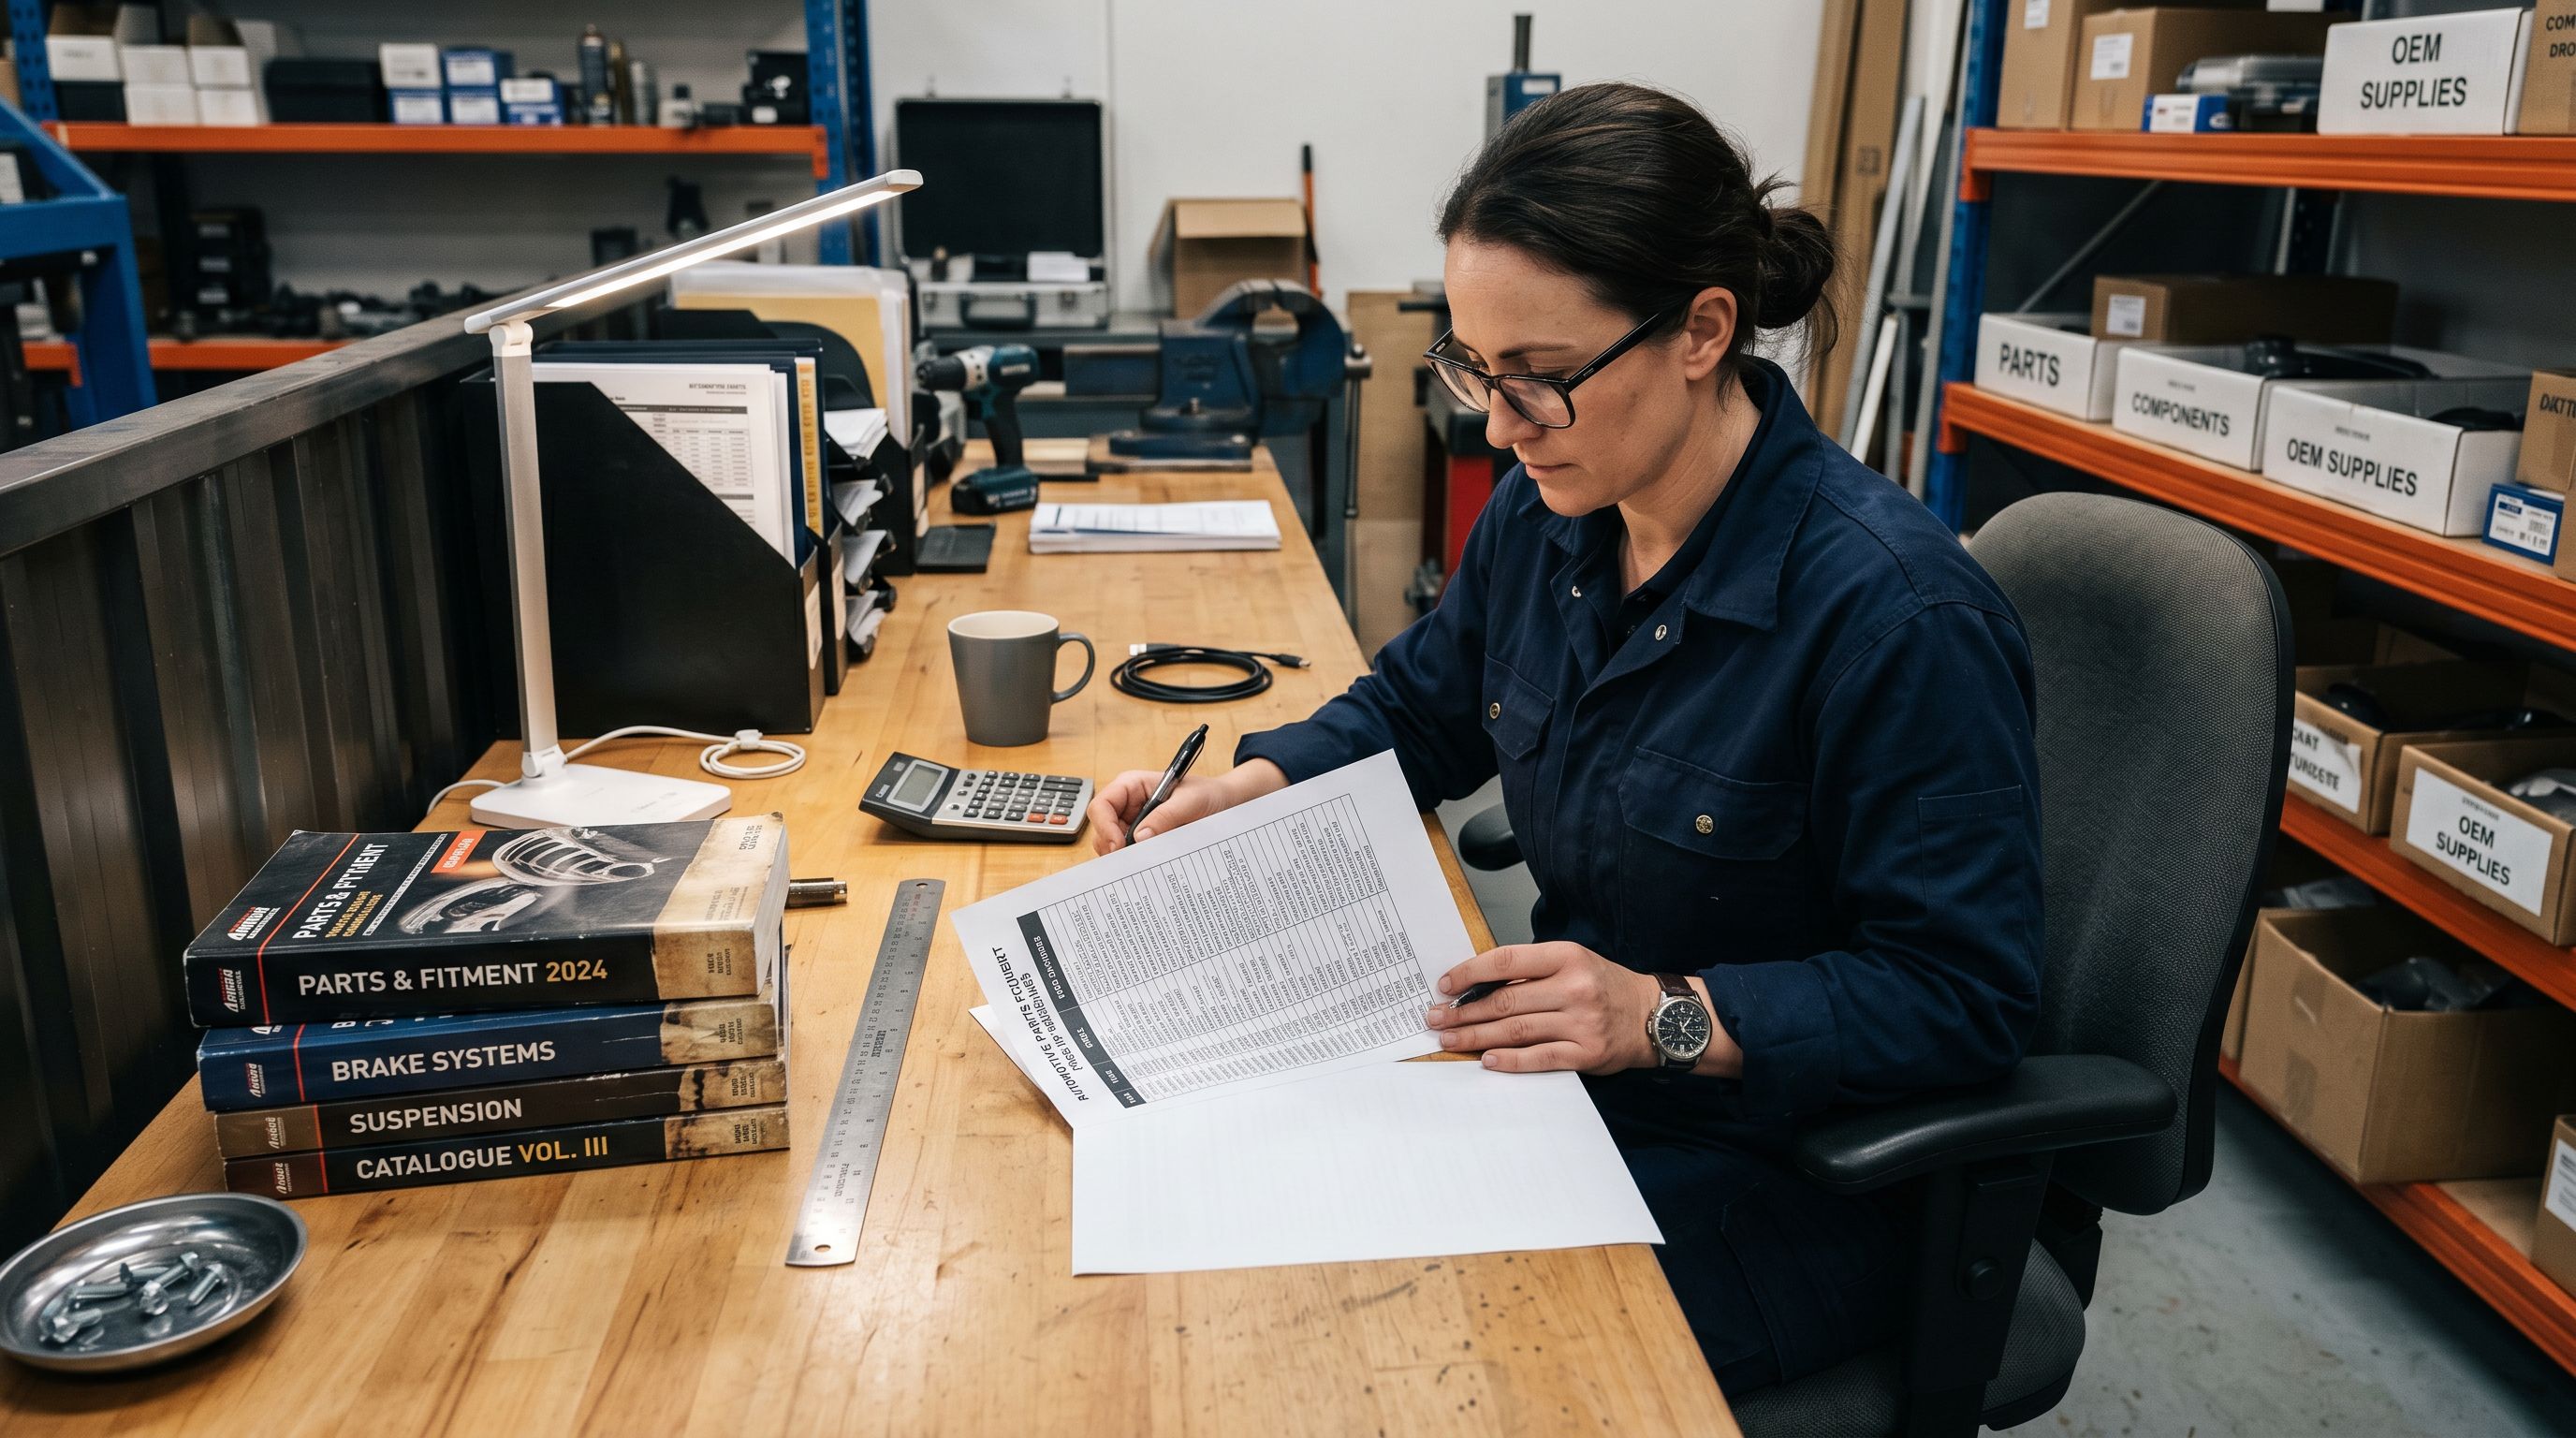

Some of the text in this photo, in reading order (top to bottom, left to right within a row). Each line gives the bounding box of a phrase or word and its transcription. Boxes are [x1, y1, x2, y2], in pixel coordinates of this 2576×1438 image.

[2392, 33, 2442, 66] OEM
[2360, 77, 2468, 110] SUPPLIES
[1999, 343, 2060, 388] PARTS
[2131, 391, 2231, 437] COMPONENTS
[2286, 438, 2418, 497] OEM SUPPLIES
[2458, 815, 2496, 848] OEM
[2436, 831, 2511, 887] SUPPLIES
[292, 904, 332, 939] PARTS
[298, 960, 608, 996] PARTS & FITMENT 2024
[331, 1040, 556, 1082] BRAKE SYSTEMS
[349, 1098, 523, 1135] SUSPENSION
[356, 1136, 608, 1181] CATALOGUE VOL. III
